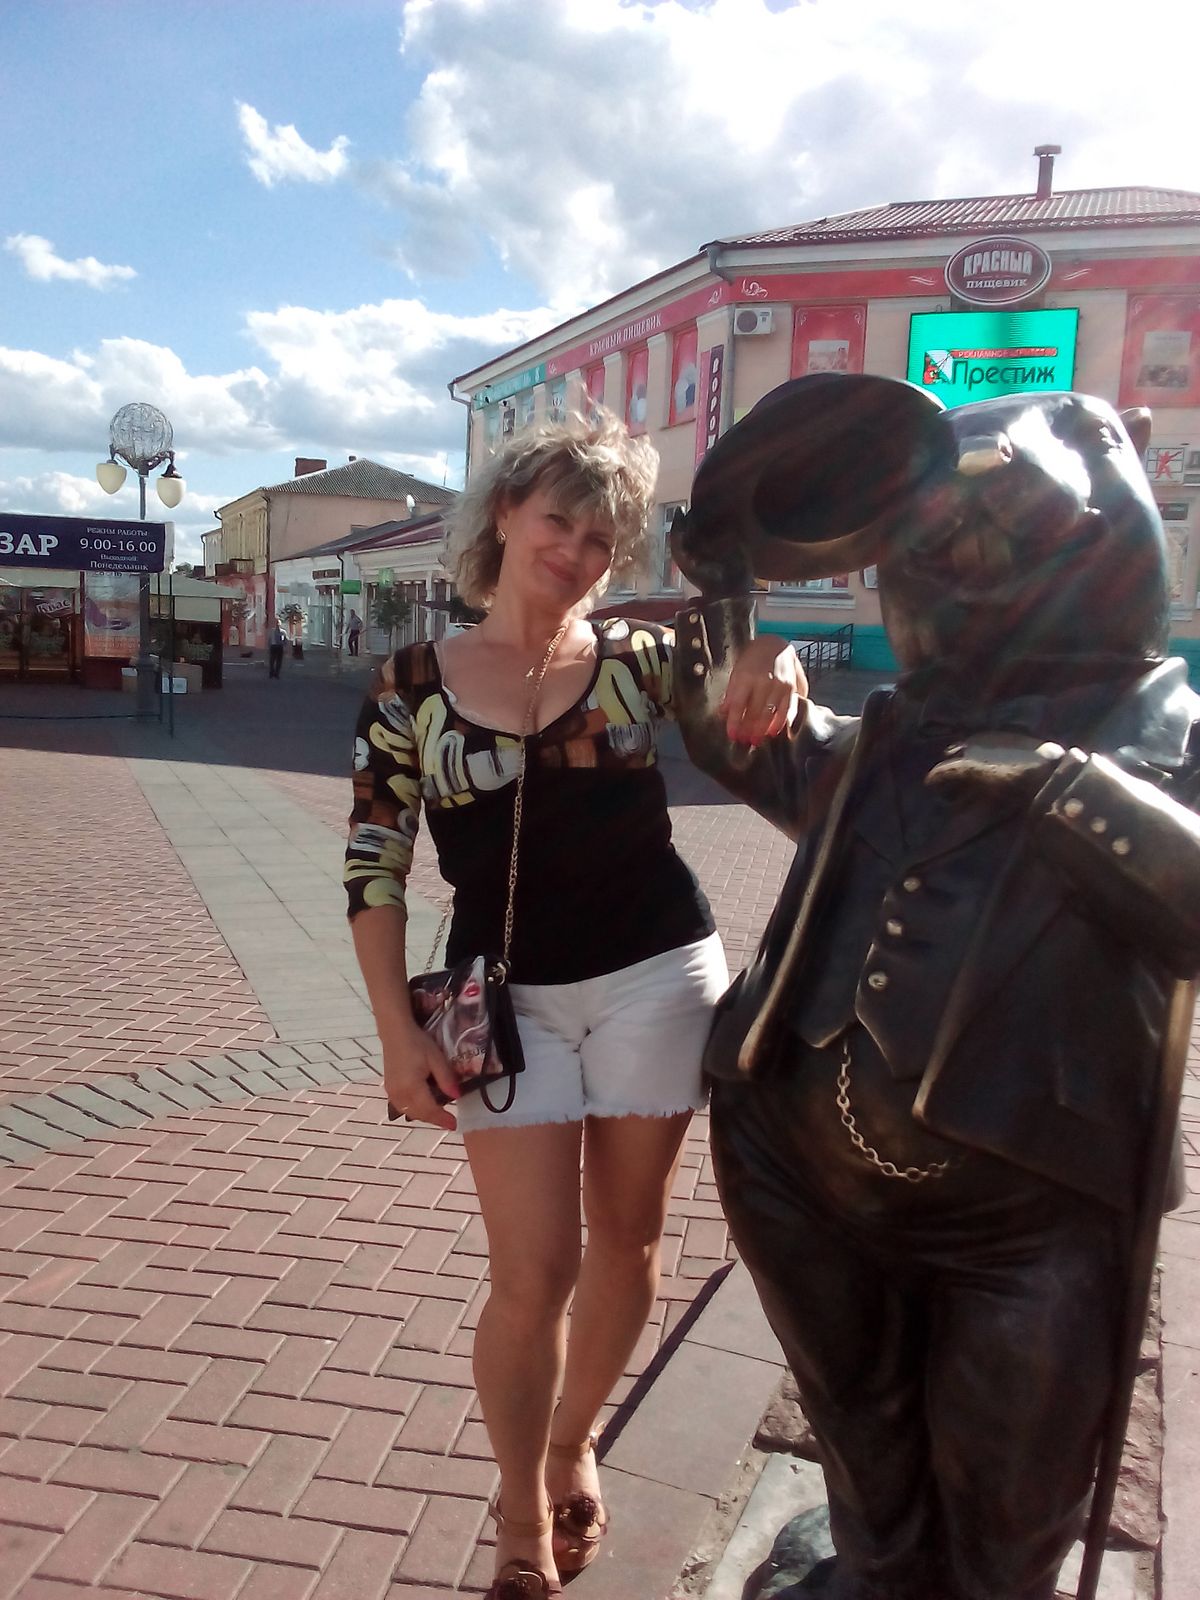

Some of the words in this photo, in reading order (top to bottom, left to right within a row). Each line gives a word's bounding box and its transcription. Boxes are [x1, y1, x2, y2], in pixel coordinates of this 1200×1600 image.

[964, 250, 1033, 278] КРАСНЫЙ
[589, 330, 622, 357] КРАСНЫЙ
[623, 313, 662, 341] ПИЩЕВИК
[953, 360, 1055, 391] Престиж
[0, 531, 59, 556] ЗАР
[87, 527, 116, 535] РЕЖИМ
[117, 528, 149, 537] РАБОТЫ
[79, 537, 157, 553] 9.00-16.00
[90, 560, 149, 571] Понедельник
